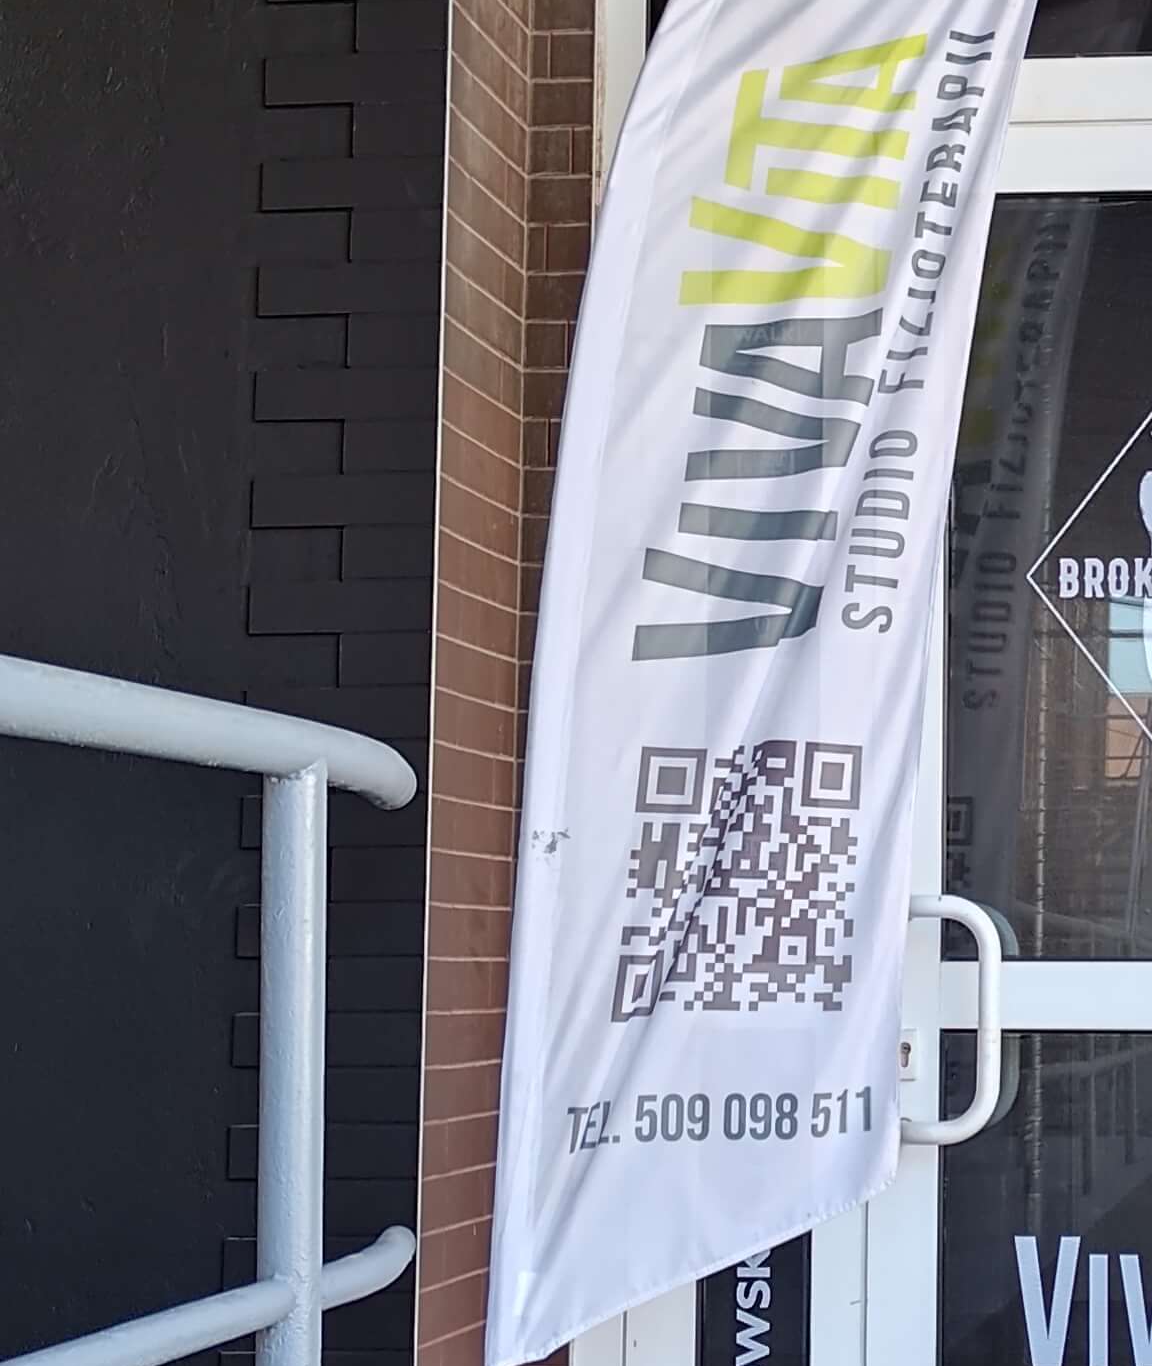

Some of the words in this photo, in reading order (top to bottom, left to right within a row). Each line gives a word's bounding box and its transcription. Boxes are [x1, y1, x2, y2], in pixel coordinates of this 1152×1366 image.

[632, 33, 928, 661] VIVAVITA
[842, 428, 919, 633] STUDIO
[567, 1100, 621, 1155] TEL.
[634, 1093, 711, 1142] 509
[722, 1092, 799, 1140] 098
[810, 1085, 873, 1138] 511
